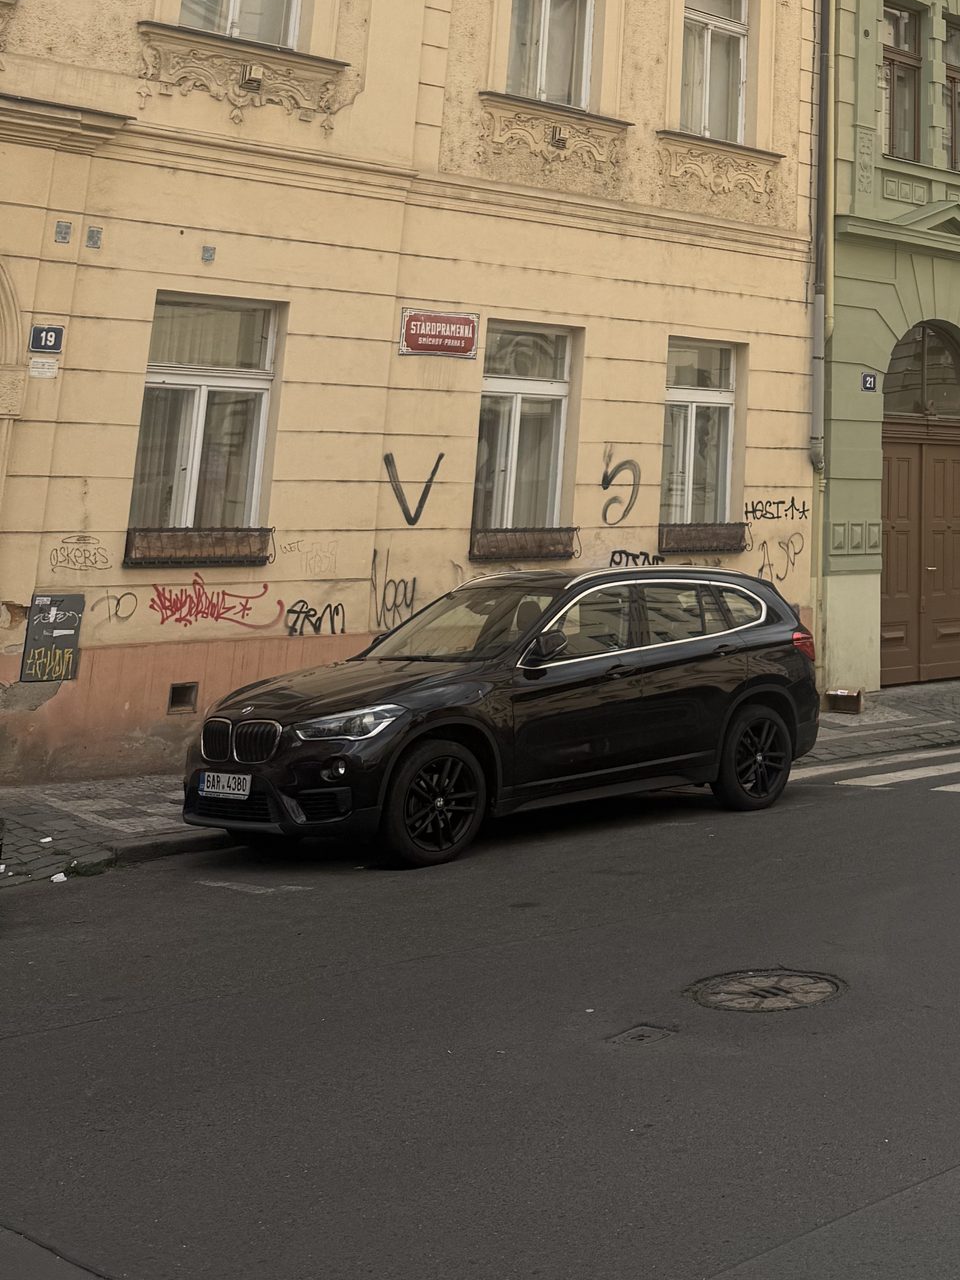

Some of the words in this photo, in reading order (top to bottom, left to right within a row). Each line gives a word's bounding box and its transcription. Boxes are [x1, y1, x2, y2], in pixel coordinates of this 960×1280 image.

[410, 321, 473, 338] STAROPRAMENNÁ
[40, 331, 56, 346] 19
[866, 376, 874, 388] 21
[206, 774, 221, 791] 6AR
[227, 775, 247, 792] 4380
